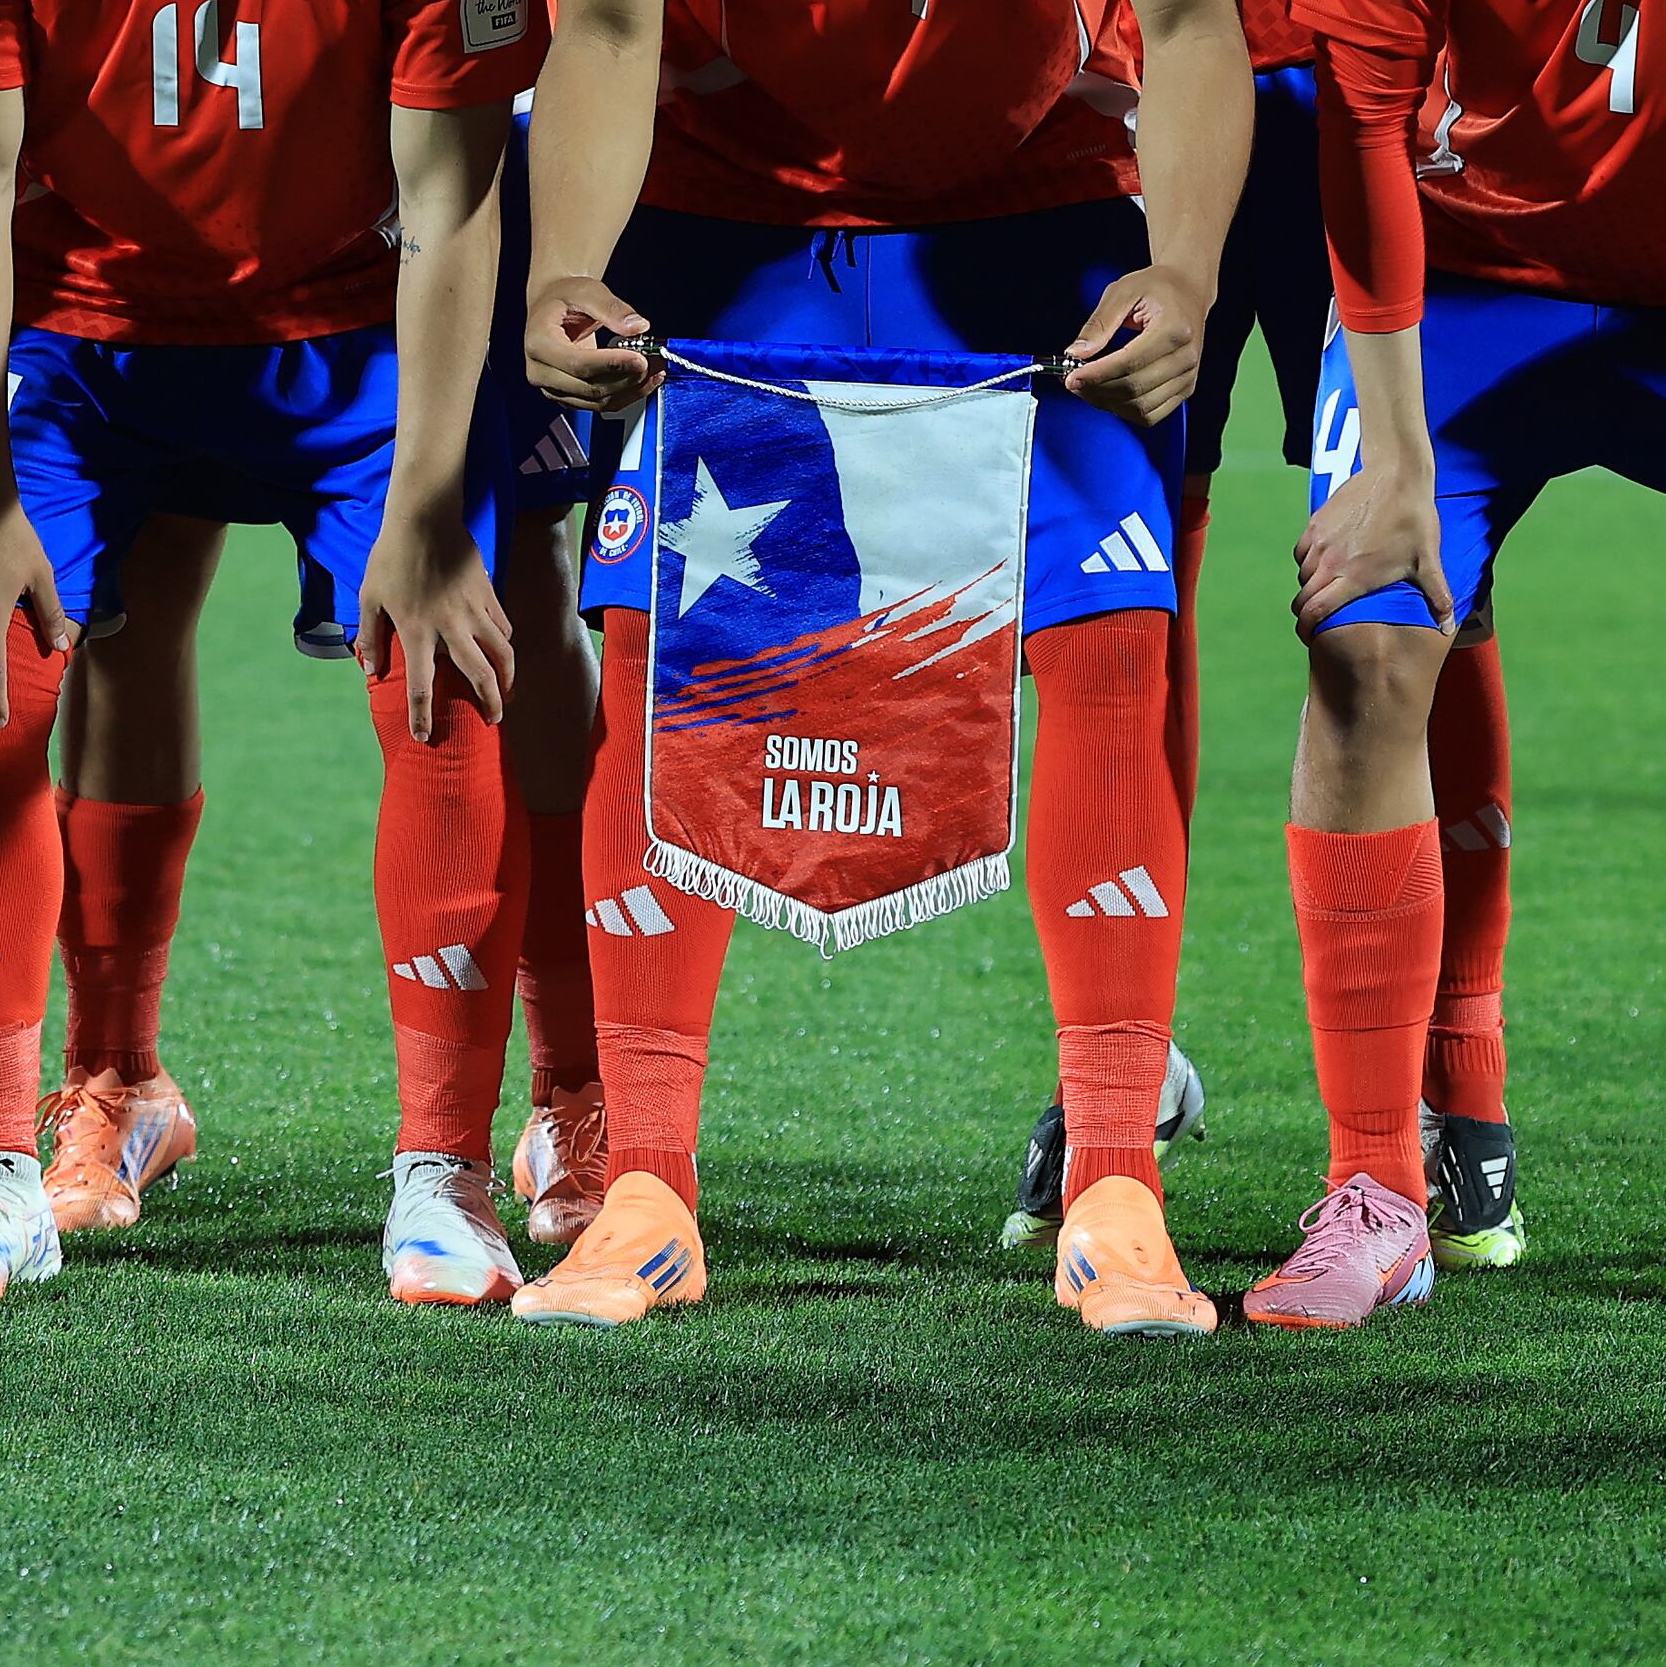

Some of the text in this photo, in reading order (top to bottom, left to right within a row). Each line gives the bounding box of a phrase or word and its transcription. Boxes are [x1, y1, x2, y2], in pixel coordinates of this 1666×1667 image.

[493, 17, 514, 27] FIFA
[1312, 387, 1362, 501] 4
[765, 734, 859, 775] SOMOS
[761, 771, 904, 839] LA ROJA
